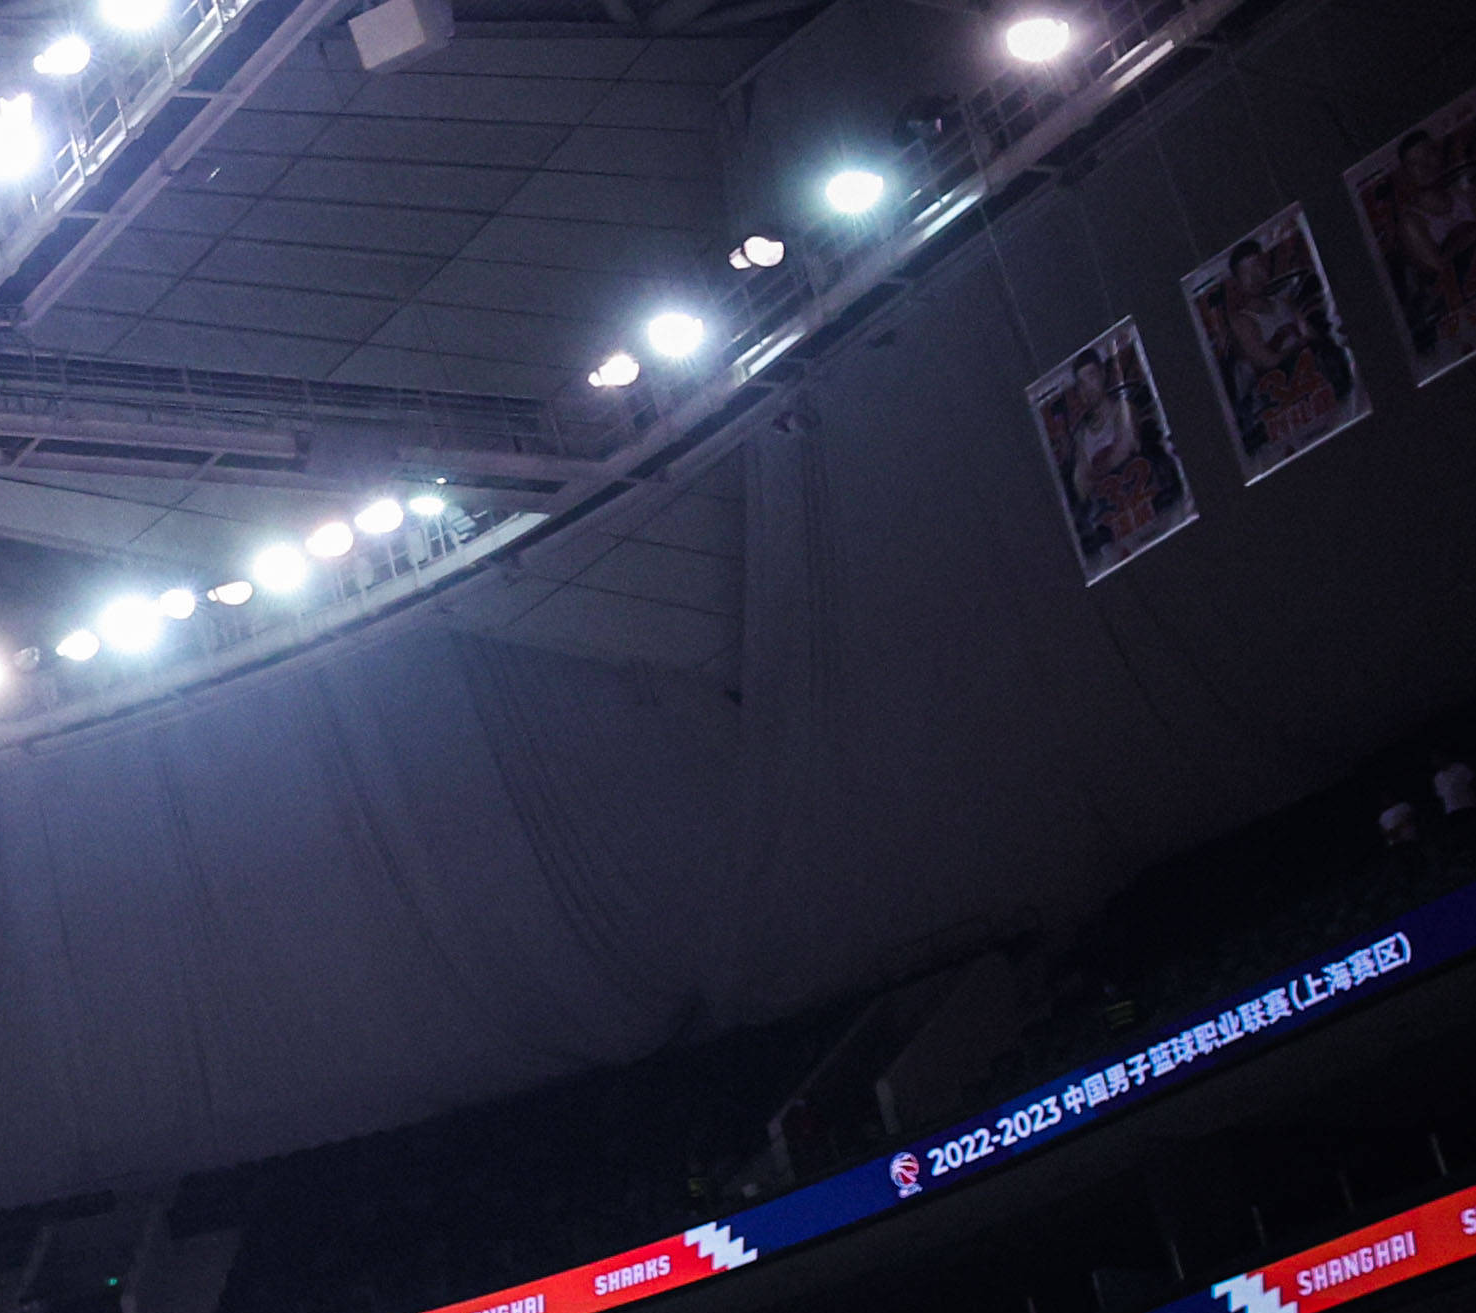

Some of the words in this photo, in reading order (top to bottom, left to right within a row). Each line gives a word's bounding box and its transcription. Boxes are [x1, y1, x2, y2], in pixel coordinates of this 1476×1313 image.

[929, 1097, 1062, 1177] 2022-2023
[594, 1254, 671, 1296] SHARKS
[1295, 1231, 1417, 1299] SHANGHAI
